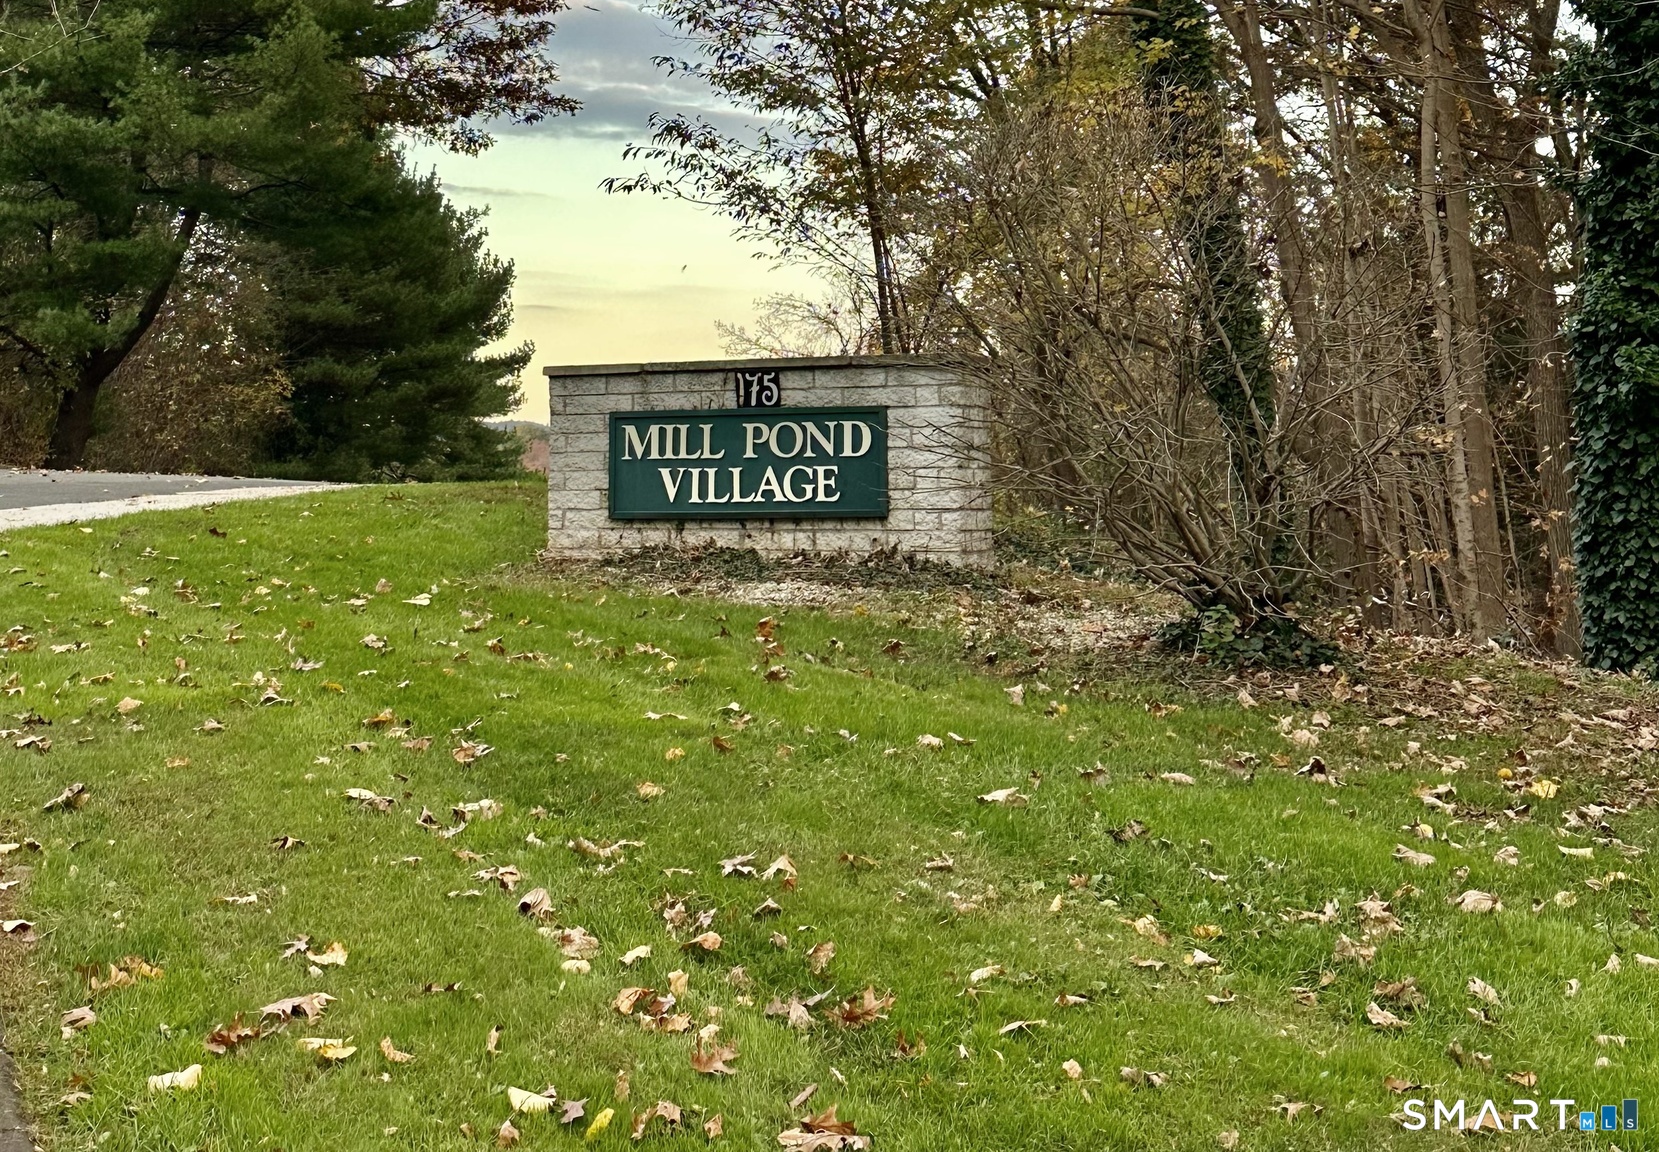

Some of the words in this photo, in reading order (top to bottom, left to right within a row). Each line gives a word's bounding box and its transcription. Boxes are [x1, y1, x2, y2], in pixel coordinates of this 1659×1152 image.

[736, 371, 780, 407] 175
[621, 423, 726, 460] MILL
[742, 420, 872, 459] POND
[657, 465, 841, 503] VILLAGE
